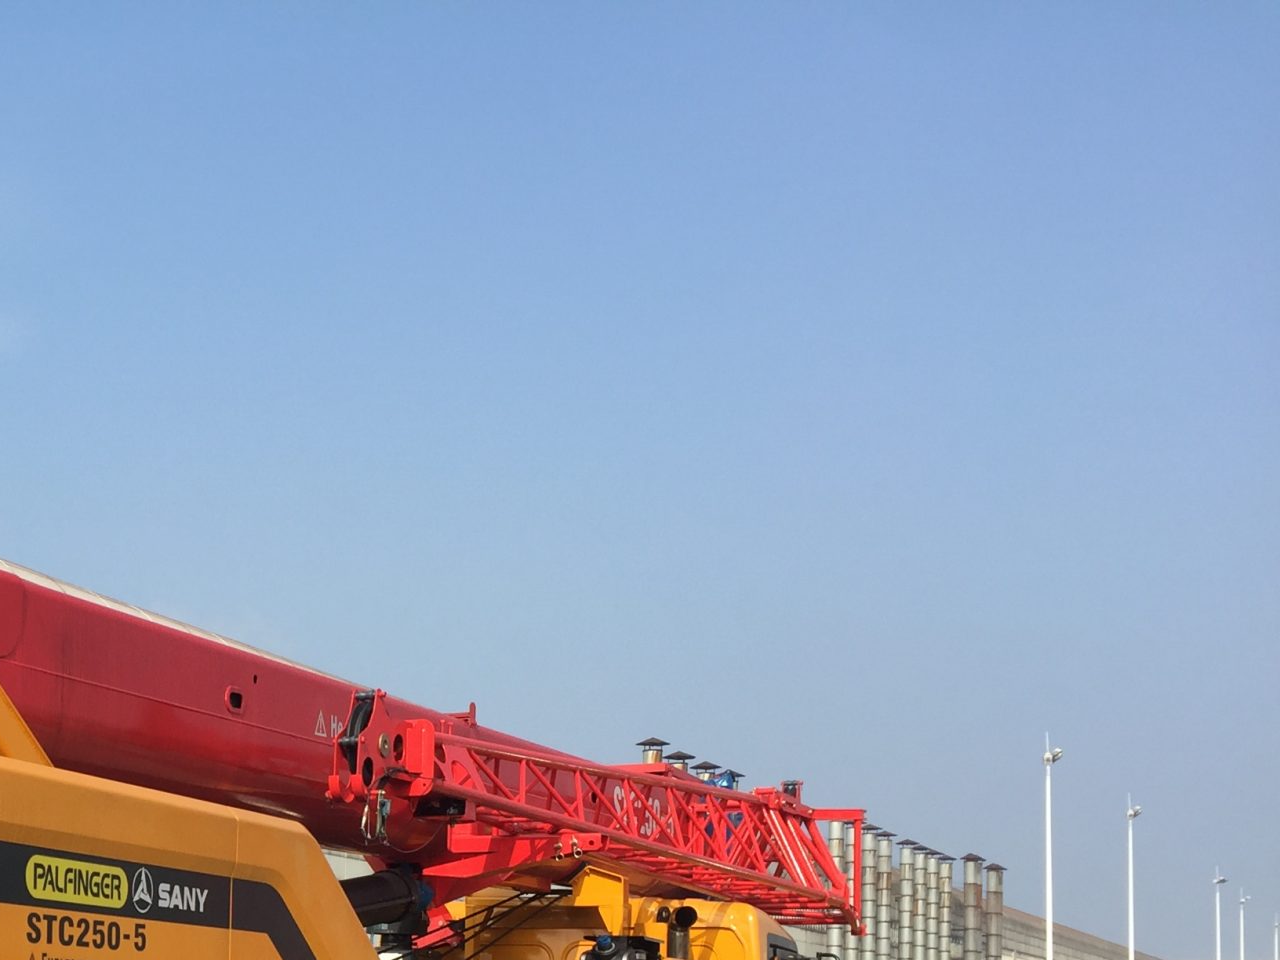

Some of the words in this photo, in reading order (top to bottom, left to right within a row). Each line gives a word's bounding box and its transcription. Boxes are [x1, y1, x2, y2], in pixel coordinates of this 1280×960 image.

[32, 862, 122, 901] PALFINGER
[157, 882, 209, 913] SANY
[25, 912, 147, 952] STC250-5
